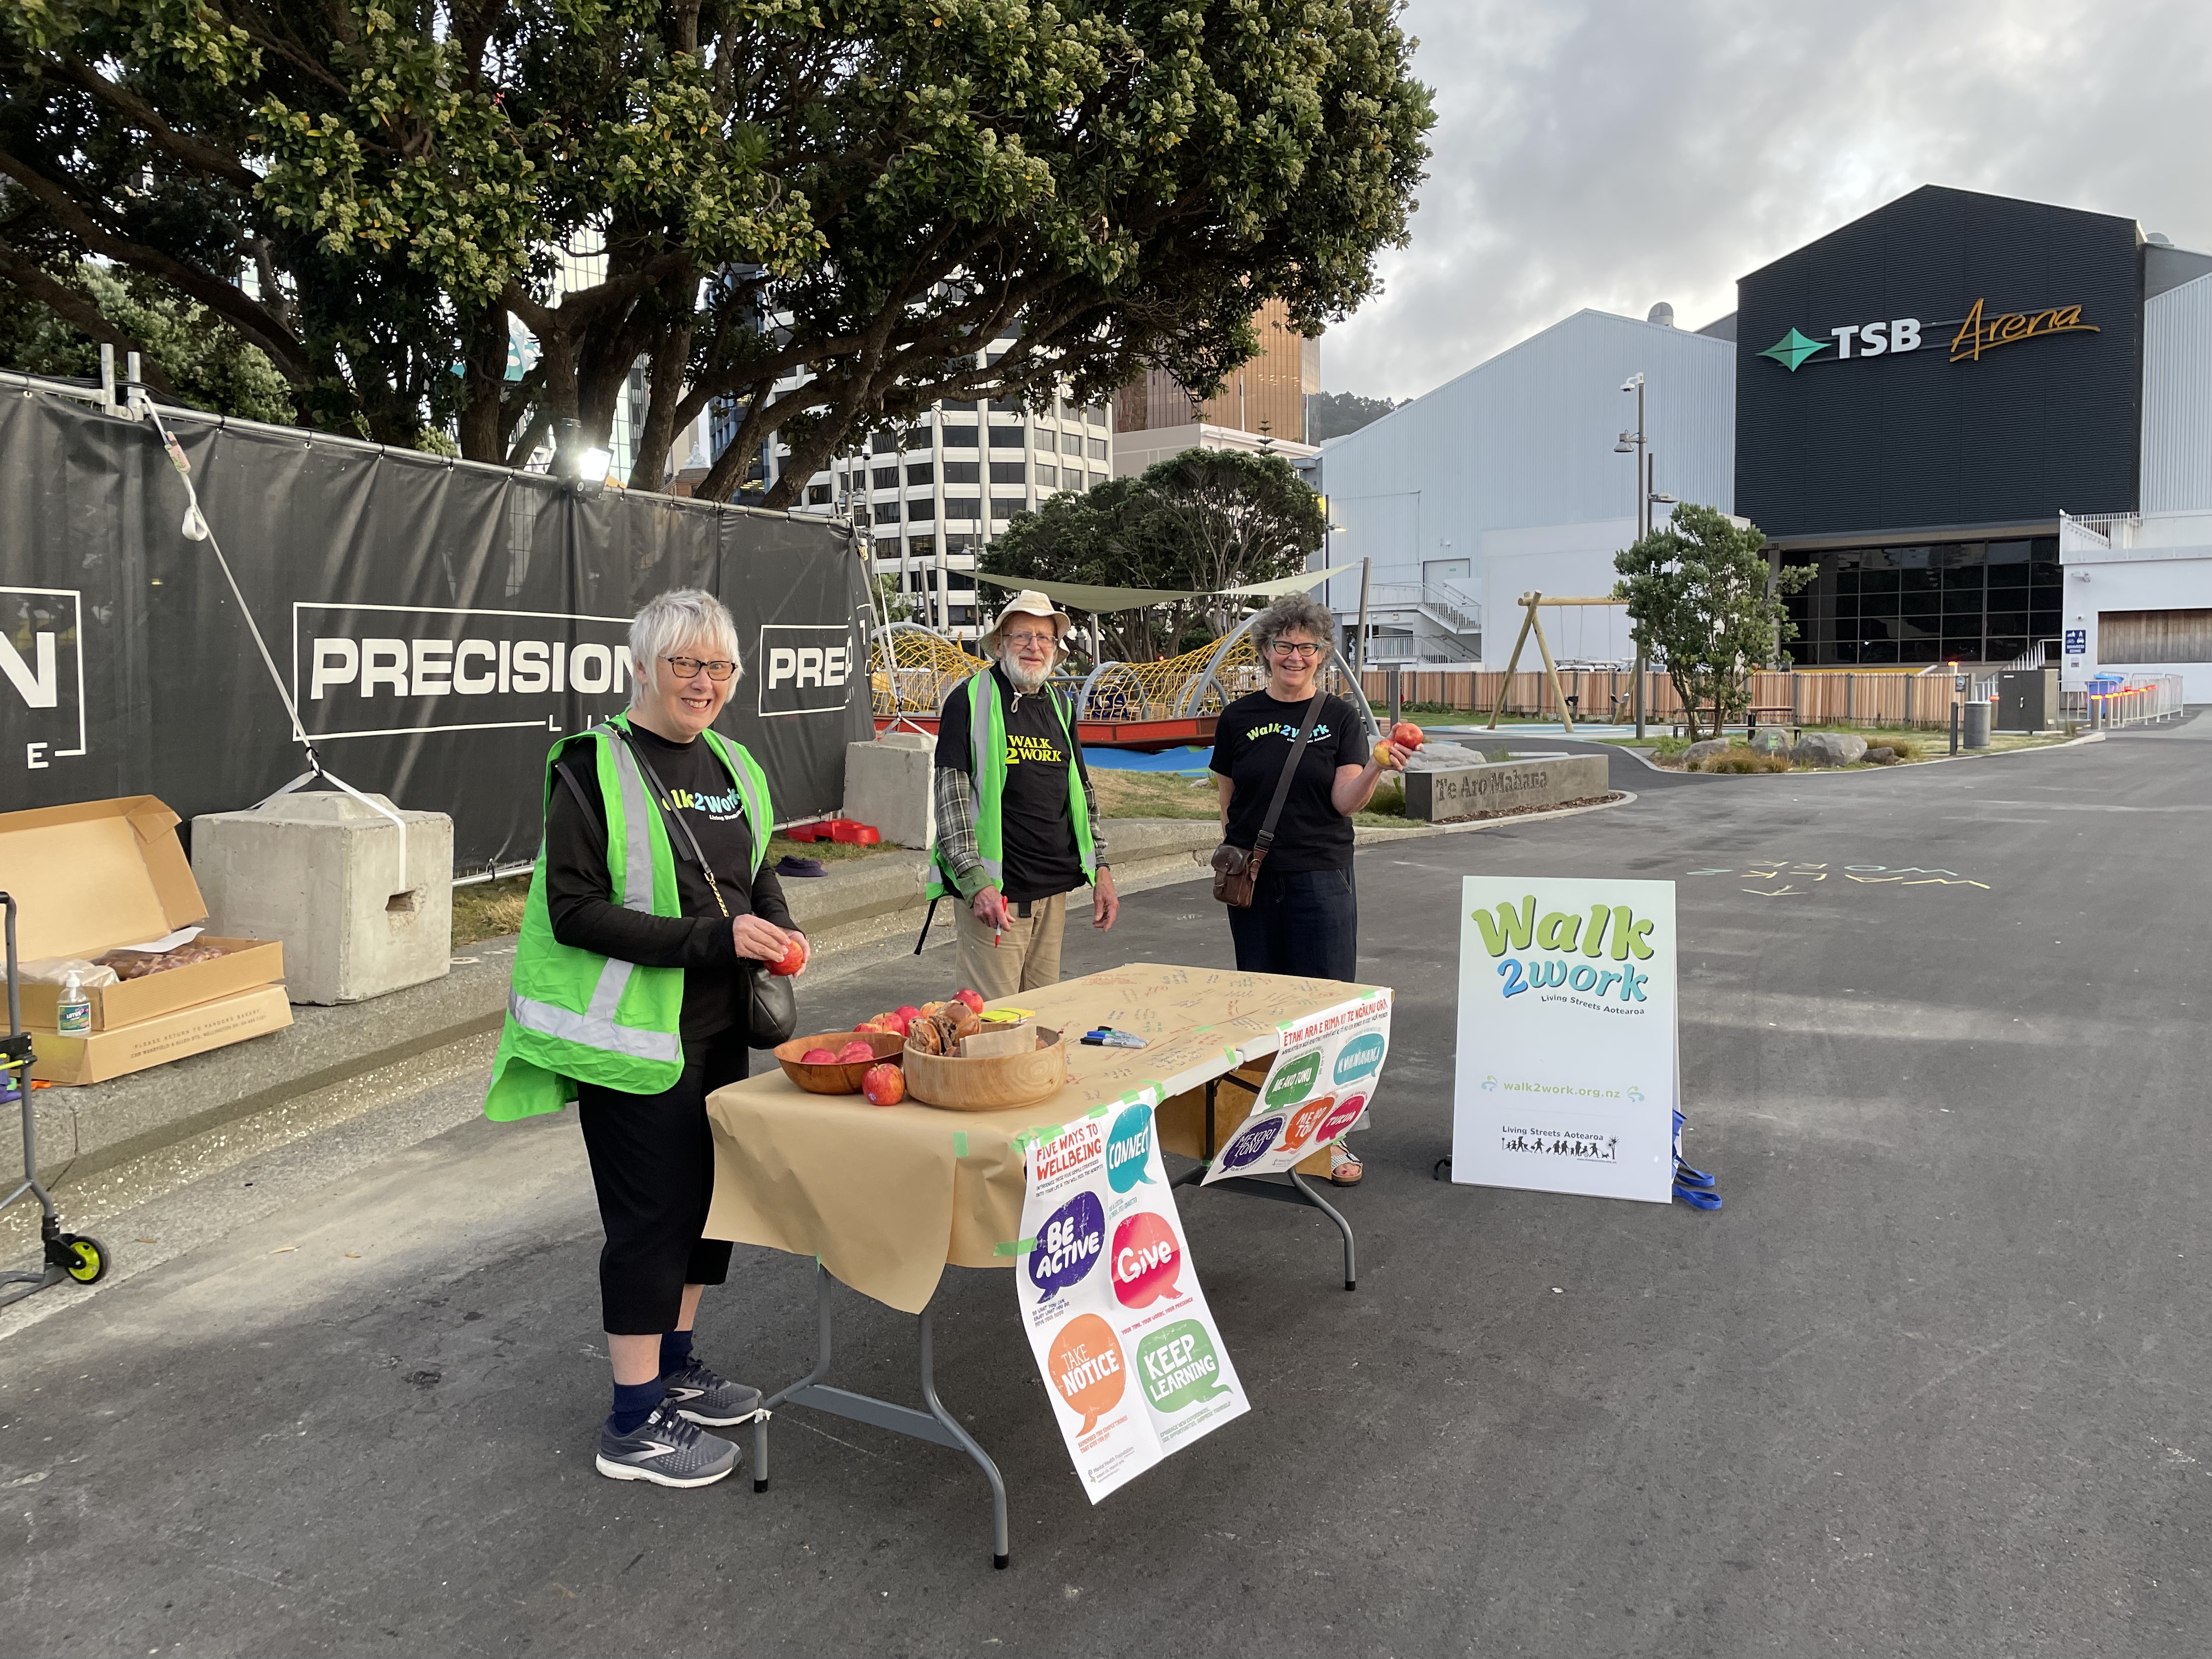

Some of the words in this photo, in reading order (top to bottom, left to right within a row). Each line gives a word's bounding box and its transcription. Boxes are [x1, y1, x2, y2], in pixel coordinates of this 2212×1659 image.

[1831, 318, 1922, 359] TSB
[1950, 298, 2100, 362] Arena
[1005, 747, 1062, 764] 2WORK
[1007, 735, 1053, 749] WALK
[1436, 778, 1457, 801] Te
[1461, 775, 1487, 798] Aro
[1490, 769, 1549, 794] Mahana
[1471, 895, 1655, 961] Walk
[1497, 958, 1649, 1002] 2work
[66, 1011, 81, 1019] LOTUS
[1570, 997, 1601, 1011] Streets
[1603, 1006, 1645, 1015] Aotearoa
[134, 1038, 160, 1048] PLEASE
[165, 1030, 189, 1040] RETURN
[237, 1009, 259, 1019] BAKERY
[1284, 1029, 1303, 1047] ĒTAHI
[1305, 1024, 1317, 1039] ARA
[1319, 1023, 1323, 1034] E
[1324, 1015, 1340, 1031] RIMA
[1347, 1010, 1354, 1022] TE
[1355, 1003, 1375, 1019] NGĀKAU
[1376, 998, 1388, 1011] ORA
[1272, 1077, 1285, 1093] ME
[1282, 1073, 1296, 1089] AKO
[1295, 1067, 1312, 1085] TONU
[1504, 1081, 1621, 1099] walk2work.org.nz
[1296, 1111, 1315, 1126] ME
[1326, 1111, 1356, 1127] TUKUA
[1037, 1141, 1058, 1162] FIVE
[1059, 1128, 1085, 1151] WAYS
[1086, 1123, 1098, 1137] TO
[1254, 1128, 1277, 1143] KORI
[1503, 1126, 1527, 1135] Living
[1530, 1128, 1561, 1137] Streets
[1564, 1131, 1604, 1141] Aotearoa
[1037, 1138, 1102, 1181] WELLBEING
[1109, 1125, 1148, 1170] CONNECT
[1234, 1141, 1265, 1156] TONU
[1072, 1167, 1082, 1176] SIMPLE
[1047, 1216, 1074, 1254] BE
[1036, 1231, 1100, 1279] ACTIVE
[1117, 1240, 1172, 1283] Give
[1034, 1313, 1044, 1321] ENJOY
[1142, 1317, 1152, 1325] YOUR
[1165, 1306, 1175, 1314] YOUR
[1175, 1297, 1193, 1309] PRESENCE
[1061, 1344, 1090, 1371] TAKE
[1143, 1334, 1195, 1380] KEEP
[1061, 1349, 1120, 1397] NOTICE
[1149, 1355, 1216, 1402] LEARNING
[1078, 1434, 1096, 1448] REMEMBER
[1080, 1445, 1090, 1454] THAT
[1093, 1464, 1104, 1473] Mental
[1104, 1457, 1115, 1466] Health
[1115, 1447, 1133, 1459] Foundation
